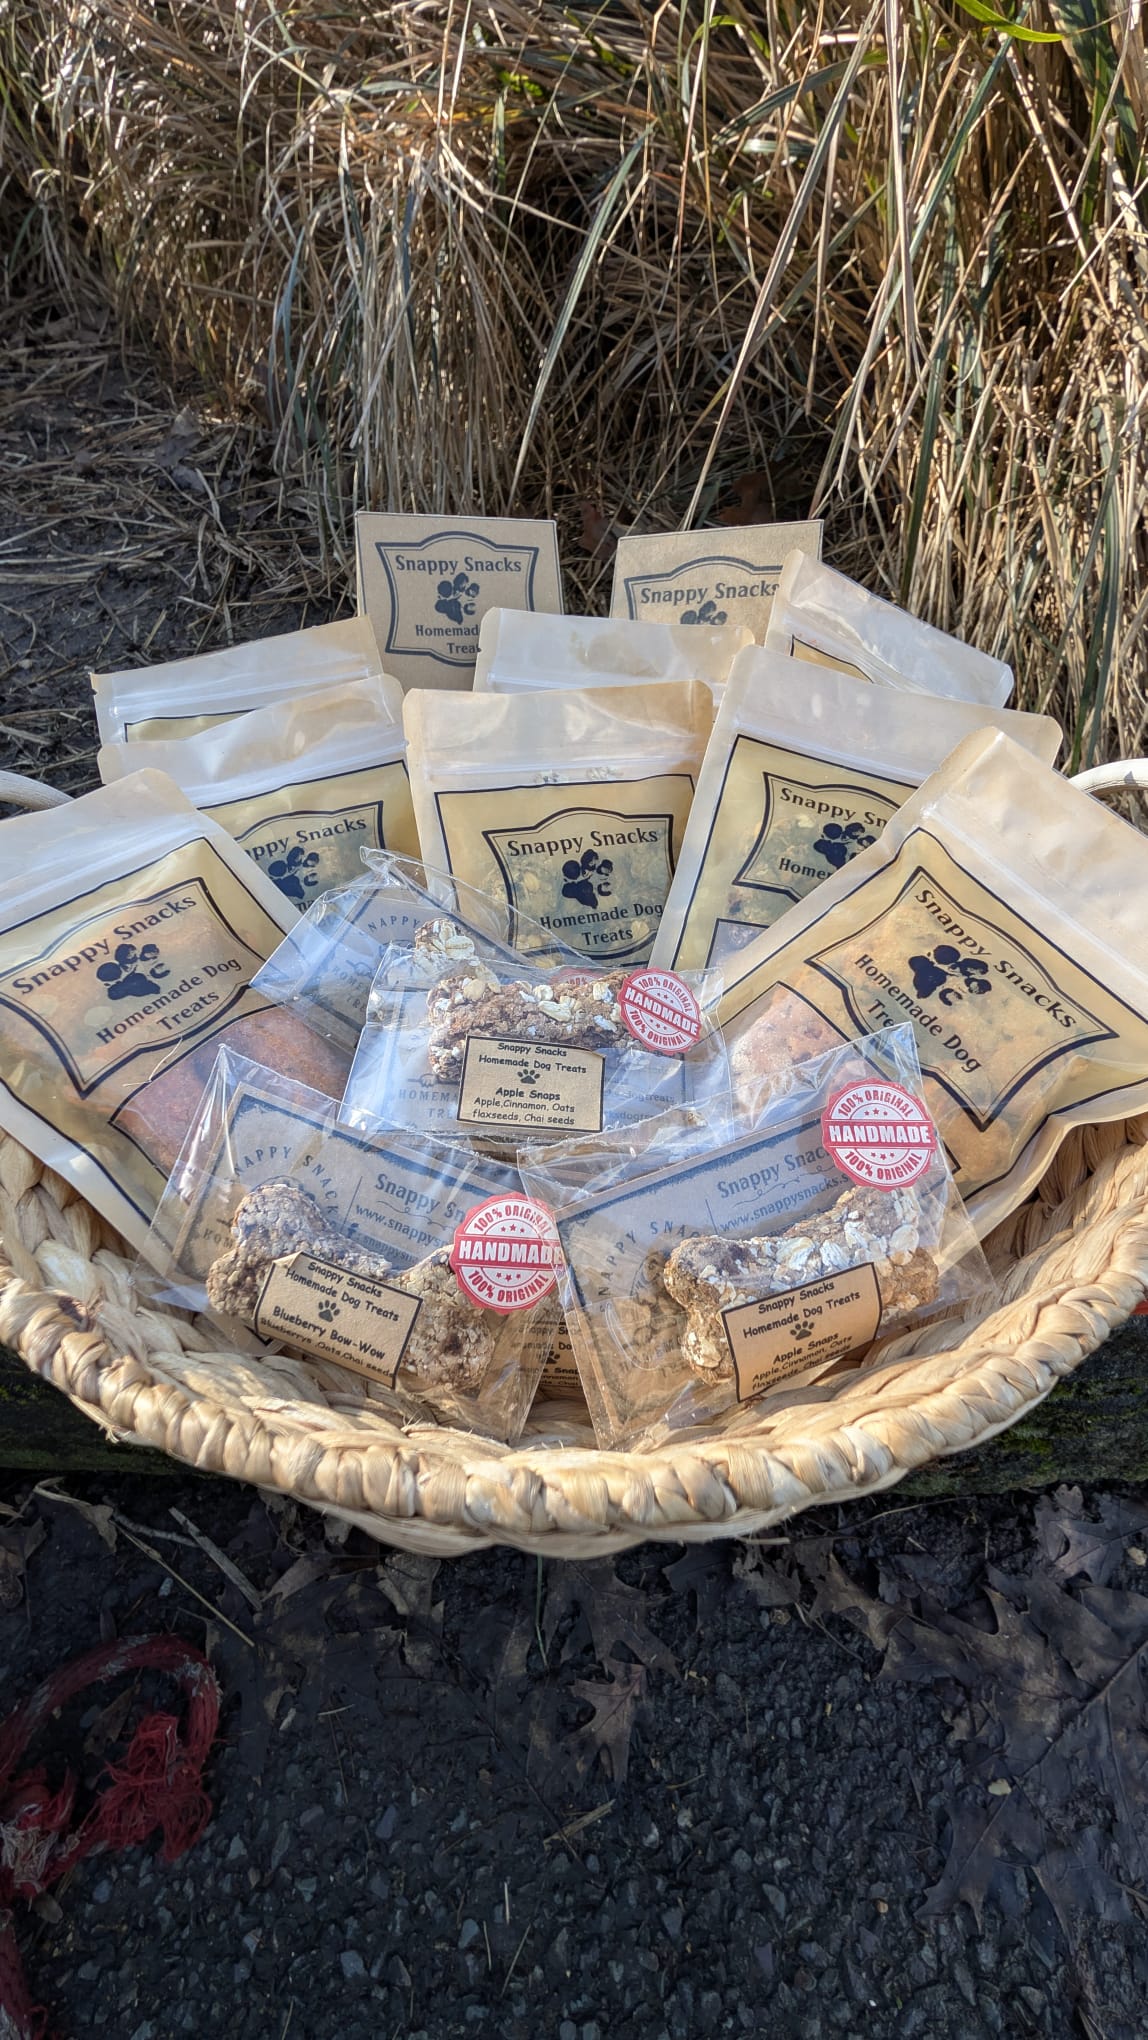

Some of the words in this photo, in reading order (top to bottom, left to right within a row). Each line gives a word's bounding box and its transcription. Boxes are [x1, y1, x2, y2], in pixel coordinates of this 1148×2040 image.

[395, 555, 458, 575] Snappy
[464, 556, 522, 572] Snacks
[641, 587, 708, 605] Snappy
[415, 624, 480, 637] Homemad
[780, 787, 857, 822] Snappy
[296, 818, 367, 844] Snacks
[507, 836, 583, 856] Snappy
[590, 827, 658, 847] Snacks
[367, 915, 421, 932] NAPPY
[540, 906, 629, 930] Homemade
[633, 903, 664, 919] Dog
[12, 938, 110, 995] Snappy
[113, 896, 197, 940] Snacks
[581, 929, 634, 946] Treats
[914, 889, 993, 957] Snappy
[993, 960, 1078, 1029] Snacks
[96, 973, 202, 1045] Homemade
[201, 958, 243, 979] Dog
[638, 976, 661, 990] 100%
[663, 979, 693, 1013] ORIGINAL
[156, 991, 220, 1032] Treats
[624, 986, 700, 1036] HANDMADE
[854, 953, 944, 1037] Homemade
[943, 1033, 983, 1074] Dog
[629, 1010, 647, 1034] 100%
[647, 1031, 687, 1046] ORIGINAL
[478, 1054, 529, 1068] Homemade
[533, 1060, 552, 1071] Dog
[555, 1062, 587, 1074] Treats
[497, 1042, 532, 1055] Snappy
[534, 1046, 568, 1057] Snacks
[495, 1087, 525, 1098] Apple
[528, 1090, 561, 1102] Snaps
[552, 1103, 575, 1113] Oats
[838, 1092, 864, 1117] 100%
[865, 1090, 914, 1118] ORIGINAL
[472, 1109, 521, 1121] flaxseeds,
[524, 1113, 544, 1123] Chai
[547, 1116, 575, 1125] seeds
[828, 1125, 931, 1144] HANDMADE
[716, 1163, 780, 1199] Snappy
[783, 1146, 830, 1172] Snac
[844, 1151, 873, 1178] 100%
[876, 1153, 922, 1181] ORIGINAL
[375, 1173, 441, 1214] Snappy
[720, 1173, 850, 1232] www.snappysnacks.s
[474, 1207, 503, 1232] 100%
[504, 1205, 552, 1236] ORIGINAL
[459, 1240, 563, 1265] HANDMADE
[285, 1268, 338, 1298] Homemade
[341, 1291, 361, 1309] Dog
[365, 1300, 400, 1322] Treats
[308, 1261, 344, 1284] Snappy
[346, 1278, 383, 1298] Snacks
[468, 1270, 496, 1299] 100%
[497, 1274, 549, 1303] ORIGINAL
[758, 1296, 795, 1314] Snappy
[800, 1281, 835, 1301] Snacks
[743, 1312, 799, 1338] Homemade
[803, 1305, 823, 1319] Dog
[826, 1291, 860, 1310] Treats
[272, 1305, 327, 1337] Blueberry
[330, 1329, 386, 1360] Bow-Wow
[558, 1341, 573, 1350] Do
[830, 1335, 852, 1349] Oats
[773, 1347, 803, 1365] Apple
[807, 1333, 839, 1351] Snaps
